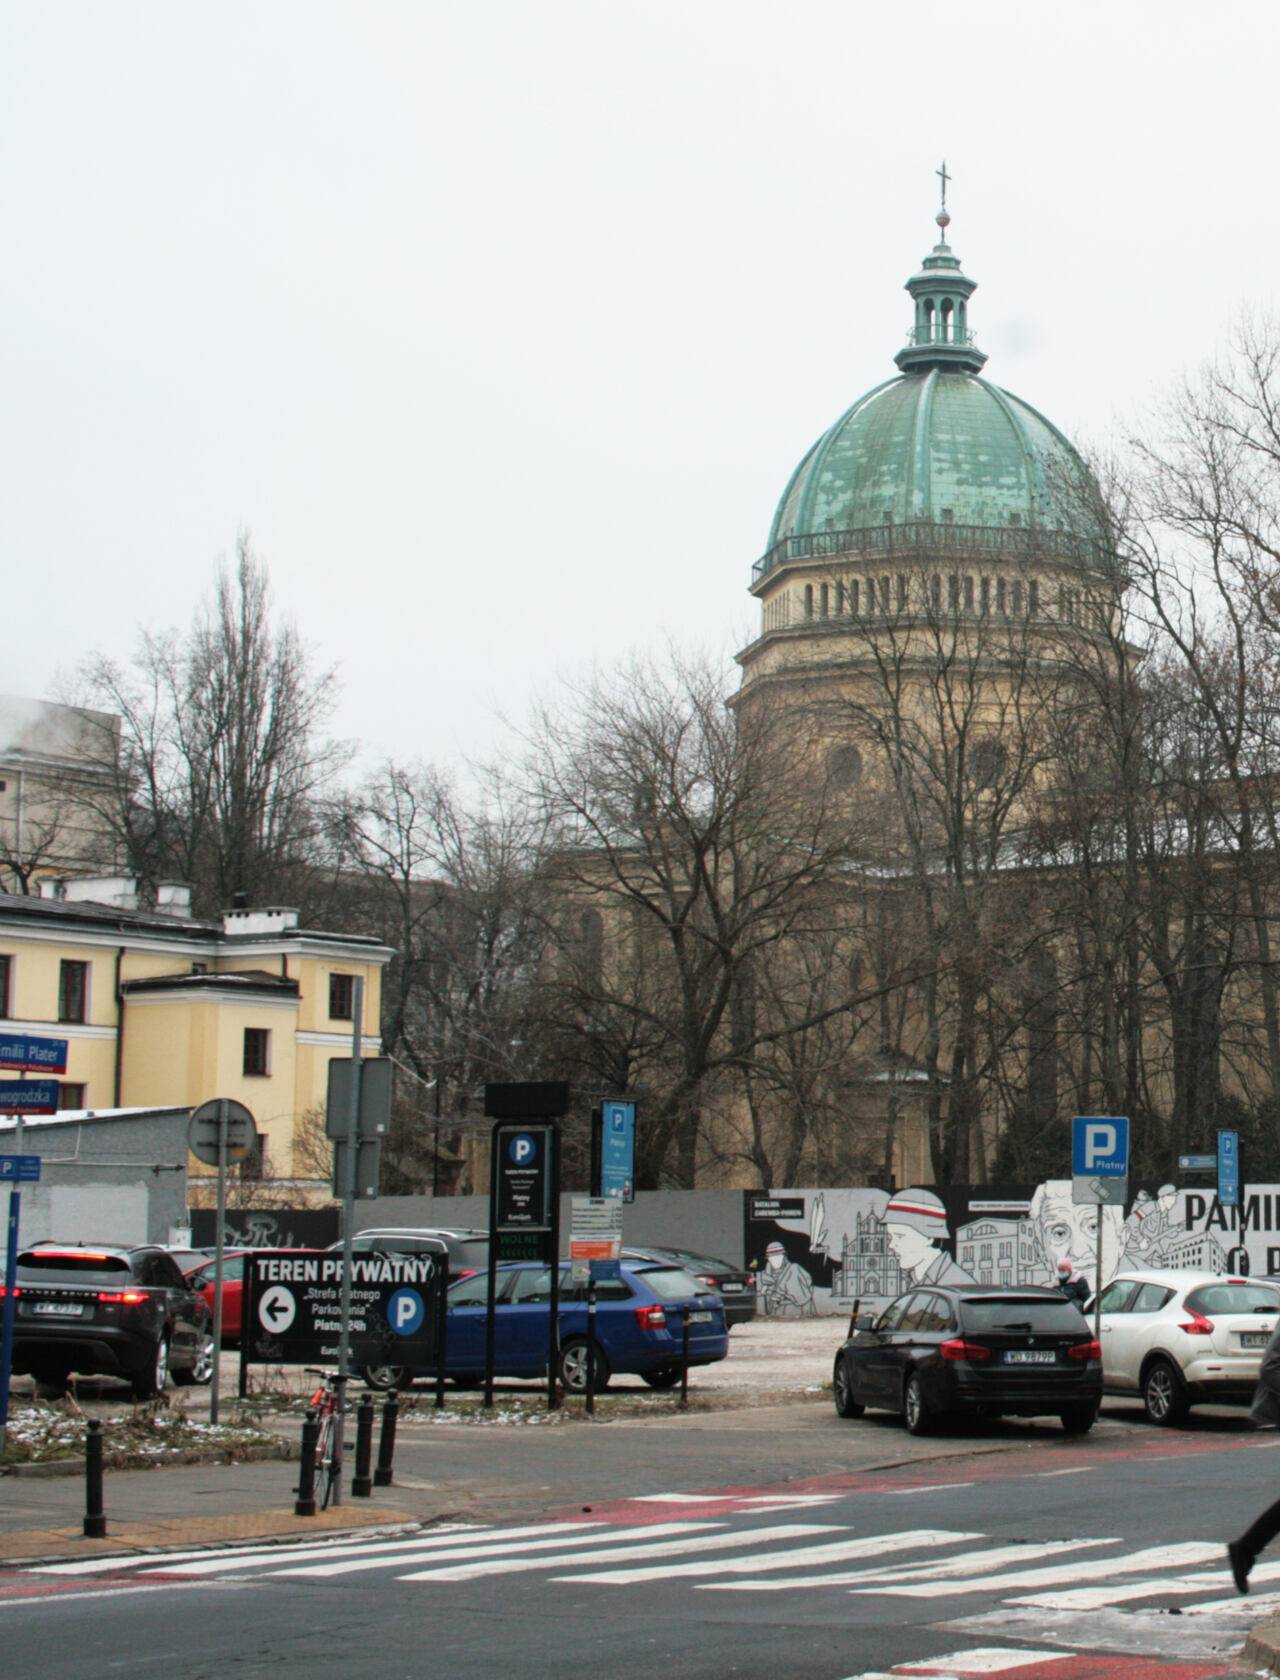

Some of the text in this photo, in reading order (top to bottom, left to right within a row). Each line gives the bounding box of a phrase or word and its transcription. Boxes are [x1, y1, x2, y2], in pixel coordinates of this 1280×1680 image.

[29, 1045, 58, 1061] Plater
[516, 1141, 530, 1160] P
[1085, 1124, 1116, 1168] P
[2, 1162, 12, 1174] P
[257, 1259, 317, 1281] TEREN
[396, 1297, 417, 1328] P
[348, 1320, 366, 1332] 24h
